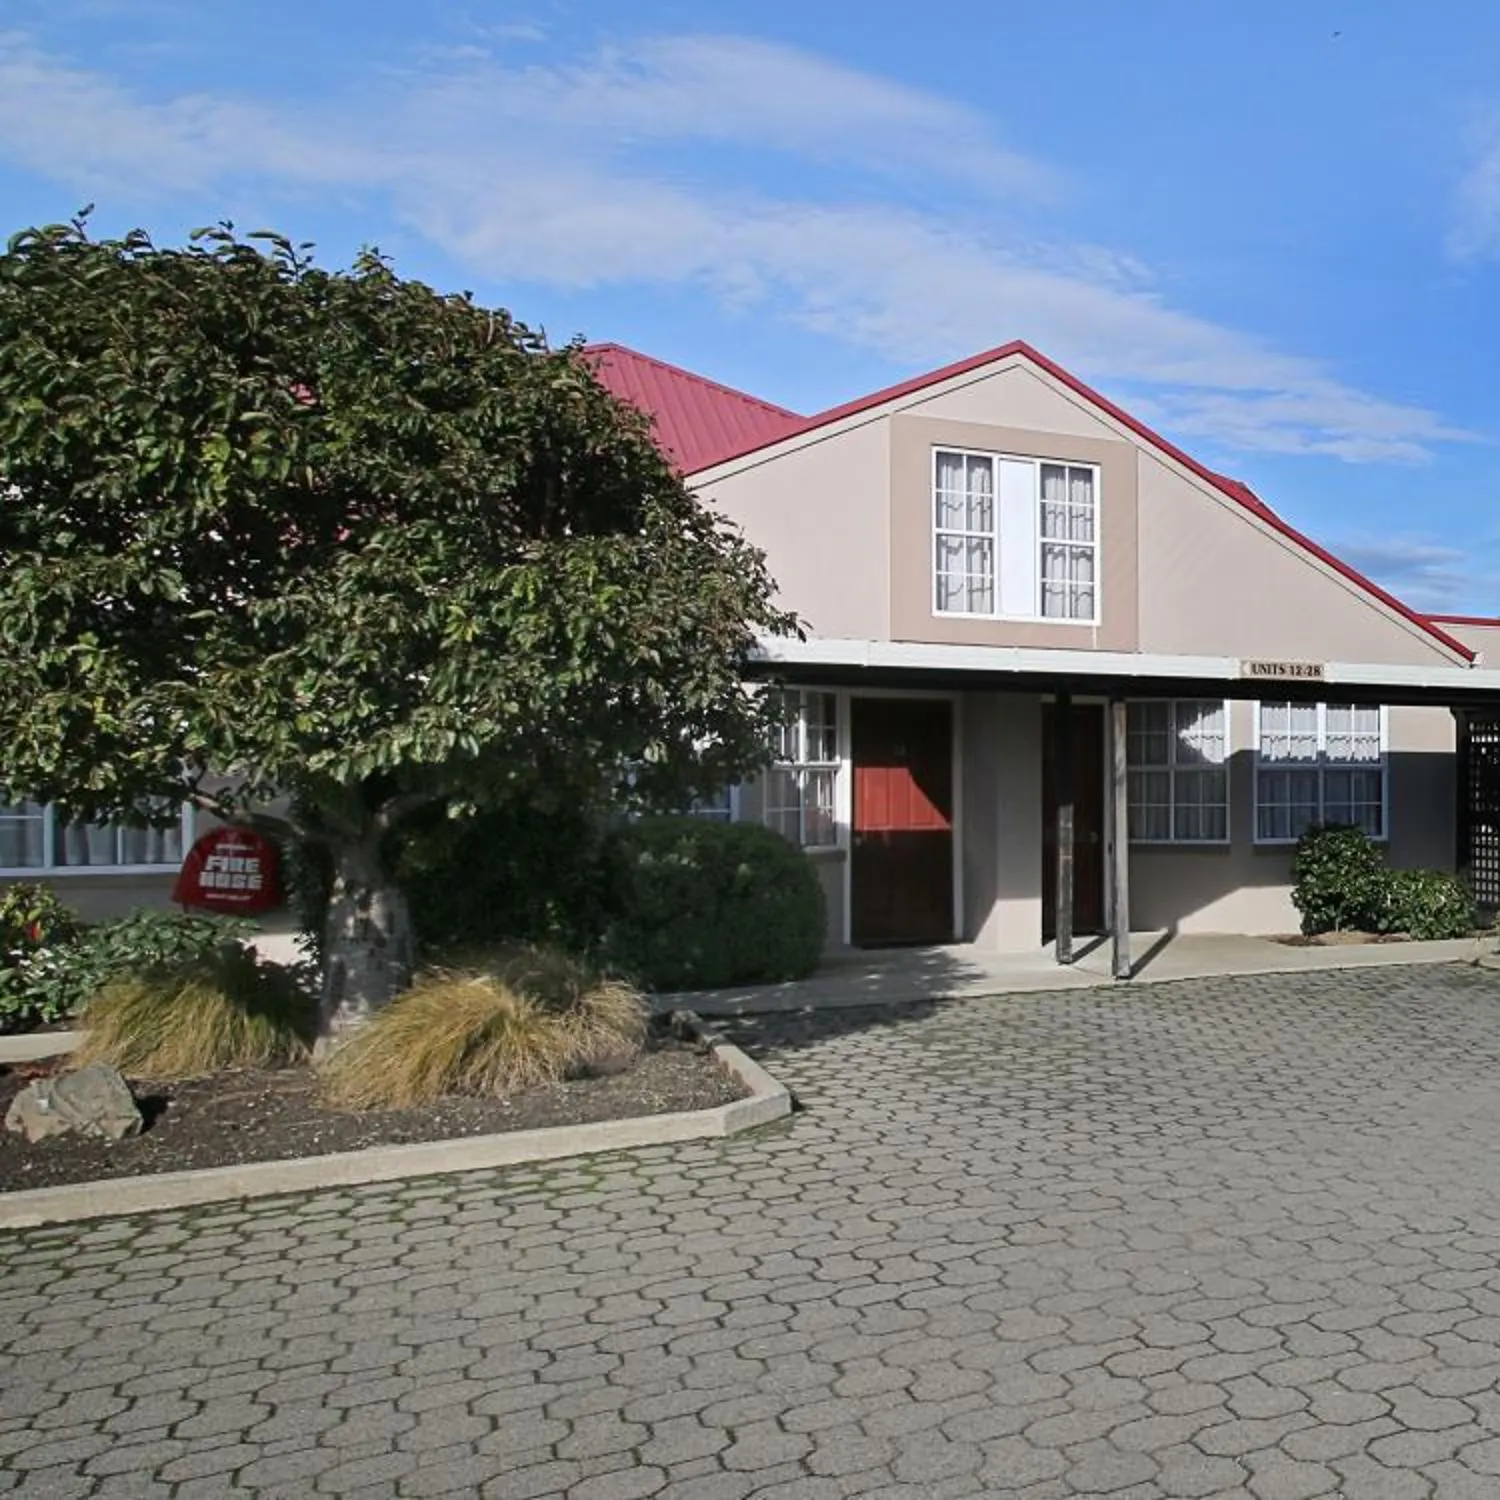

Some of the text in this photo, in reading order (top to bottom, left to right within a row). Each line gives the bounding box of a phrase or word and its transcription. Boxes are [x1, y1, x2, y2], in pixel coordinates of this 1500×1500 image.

[1252, 663, 1321, 677] UNITS 12-28
[205, 855, 260, 873] FIRE
[199, 871, 264, 890] HOSE
